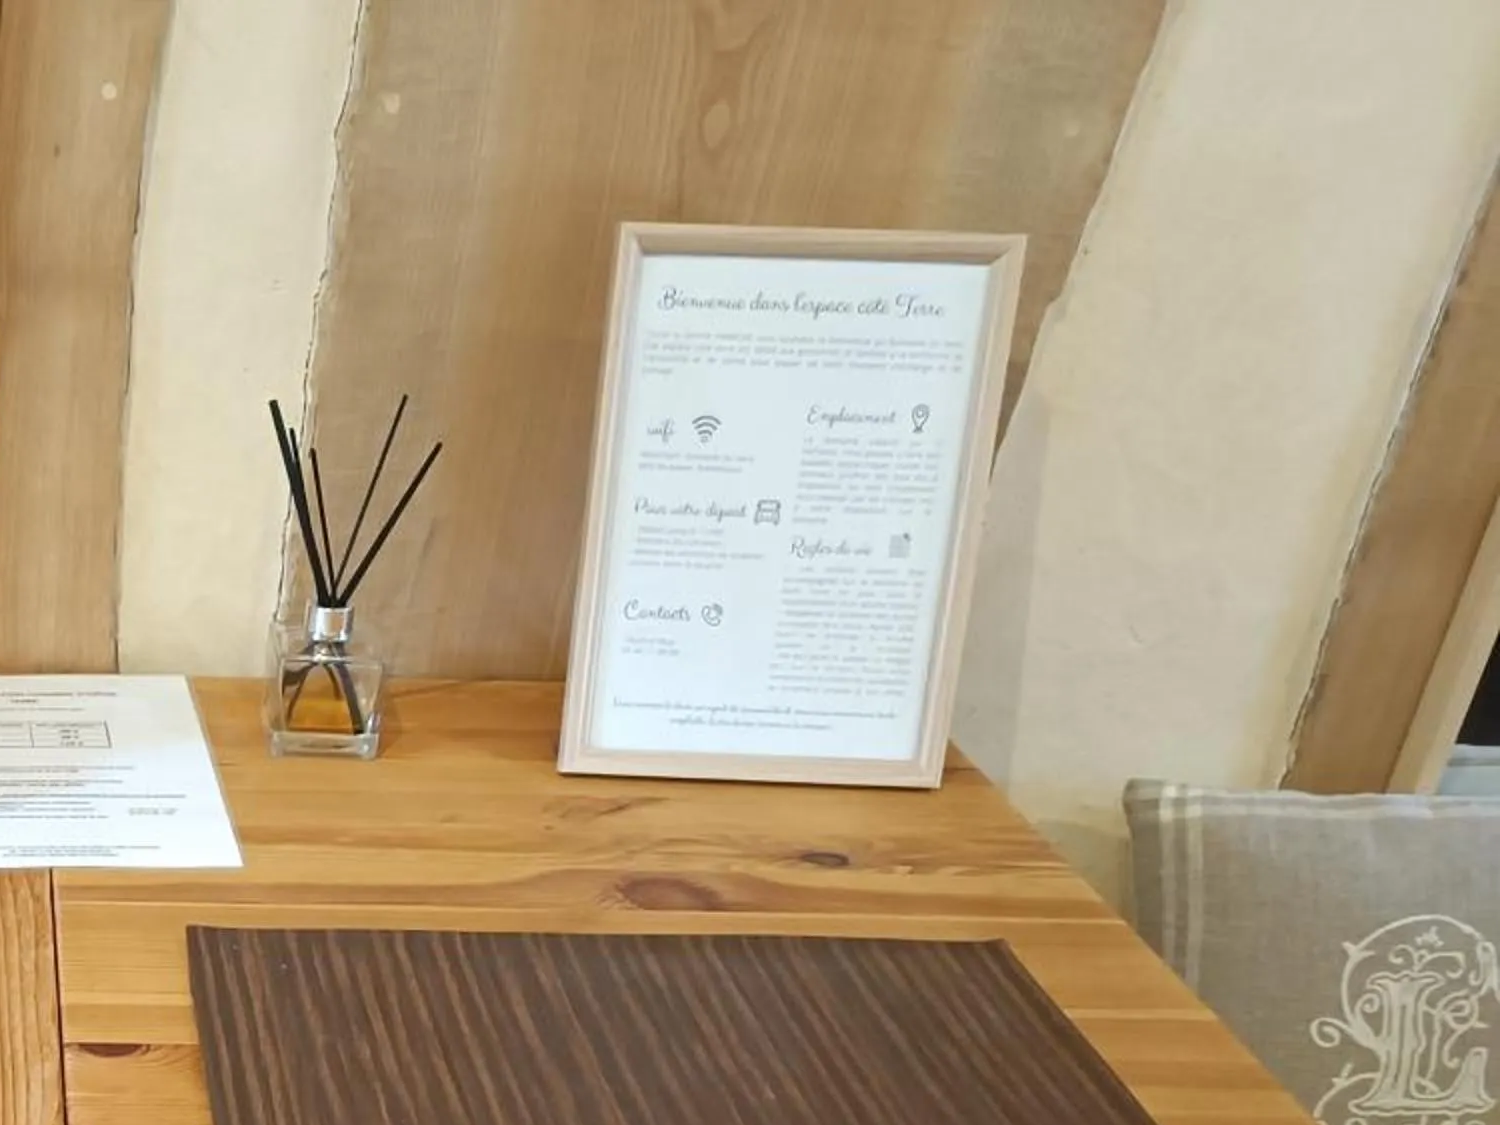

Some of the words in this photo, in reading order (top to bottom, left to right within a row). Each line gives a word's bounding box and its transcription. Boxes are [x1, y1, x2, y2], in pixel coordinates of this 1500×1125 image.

[657, 286, 746, 311] Bienvenue
[749, 291, 789, 312] dans
[895, 293, 945, 319] Terre
[806, 404, 897, 429] Emplacement
[623, 598, 692, 622] Contacts
